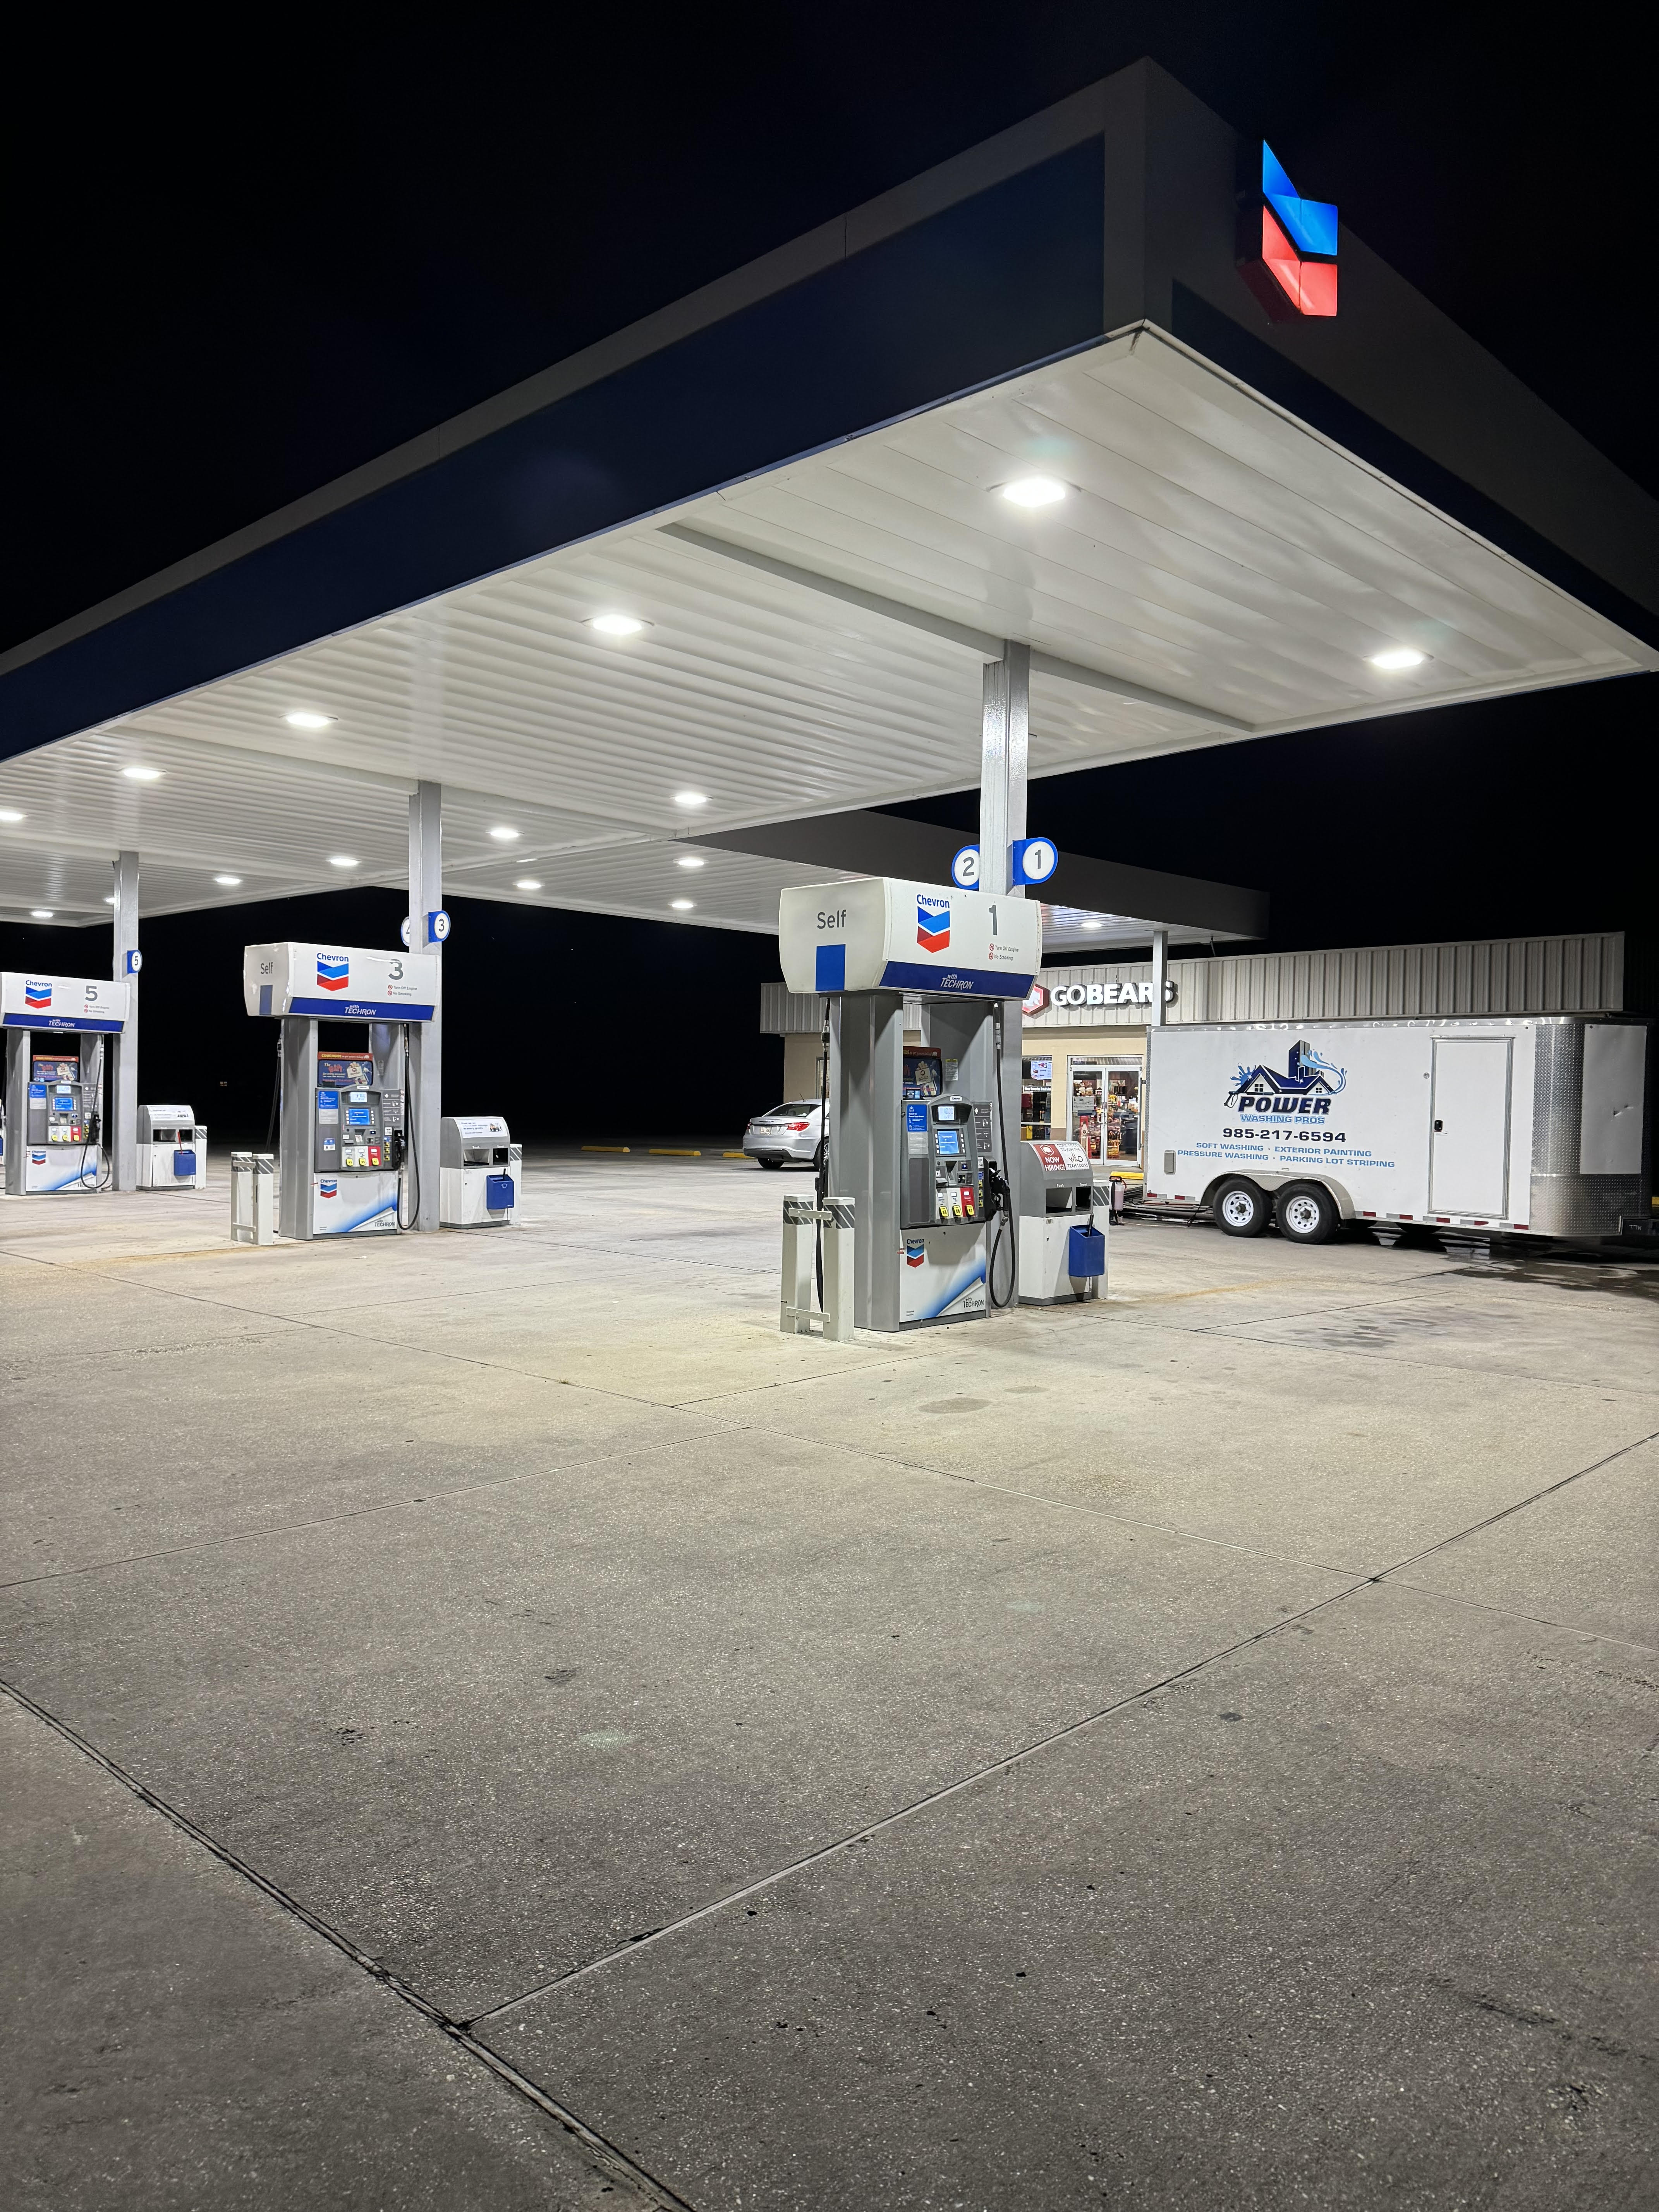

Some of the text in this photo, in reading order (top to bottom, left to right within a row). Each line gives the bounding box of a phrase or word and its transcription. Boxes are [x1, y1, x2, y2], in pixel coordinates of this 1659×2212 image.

[1035, 849, 1041, 869] 1
[963, 857, 974, 877] 2
[917, 894, 950, 908] Chevron
[439, 919, 445, 932] 3
[817, 909, 847, 929] Self
[989, 905, 997, 936] 1
[134, 956, 138, 965] 5
[317, 953, 349, 962] Chevron
[261, 963, 273, 974] Self
[388, 959, 404, 980] 3
[940, 977, 974, 990] TECHRON
[85, 985, 98, 1001] 5
[345, 1007, 376, 1015] TECHRON
[1238, 1096, 1331, 1115] POWER
[1241, 1115, 1325, 1124] WASHING PROS
[1223, 1128, 1346, 1142] 985-217-6594
[1069, 1152, 1083, 1163] WILD
[1324, 1149, 1372, 1157] PAINTING
[1347, 1159, 1395, 1168] STRIPING
[963, 1300, 984, 1308] TECHRON
